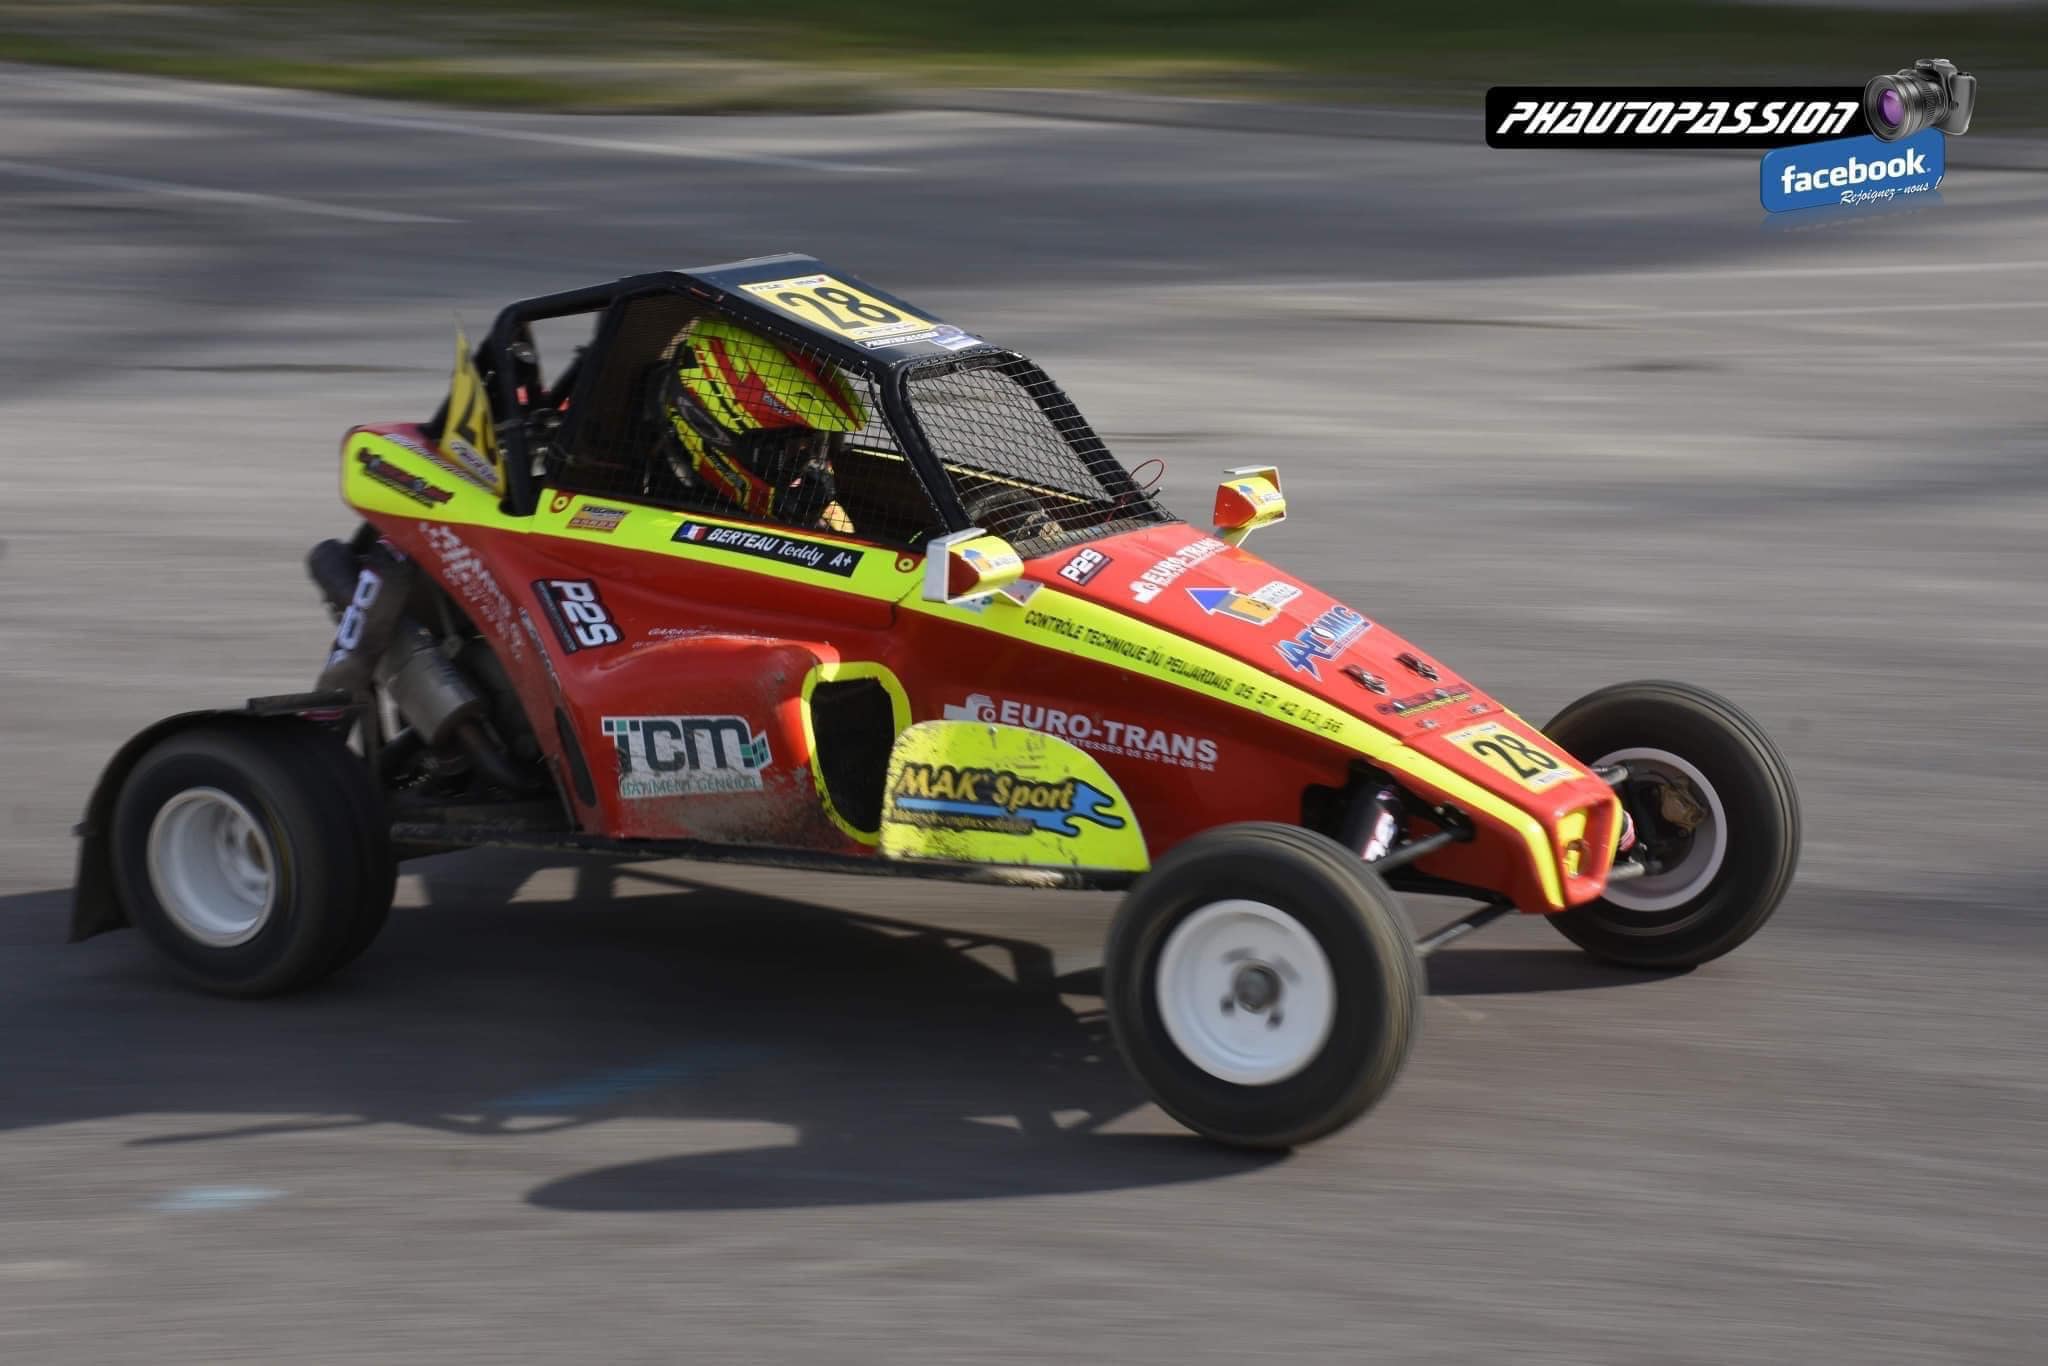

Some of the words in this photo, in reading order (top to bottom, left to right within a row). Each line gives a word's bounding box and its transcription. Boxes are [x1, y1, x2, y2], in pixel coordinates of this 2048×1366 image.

[776, 286, 903, 331] 28
[707, 528, 780, 552] BERTEAU
[777, 540, 824, 566] Teddy
[829, 551, 852, 567] A+
[1061, 548, 1104, 582] P2S
[550, 580, 619, 647] P2S
[1085, 627, 1148, 661] TECHNIQUE
[1273, 605, 1364, 682] ATOMIC
[1000, 699, 1218, 764] EURO-TRANS
[1472, 734, 1560, 779] 28
[992, 774, 1074, 814] Sport
